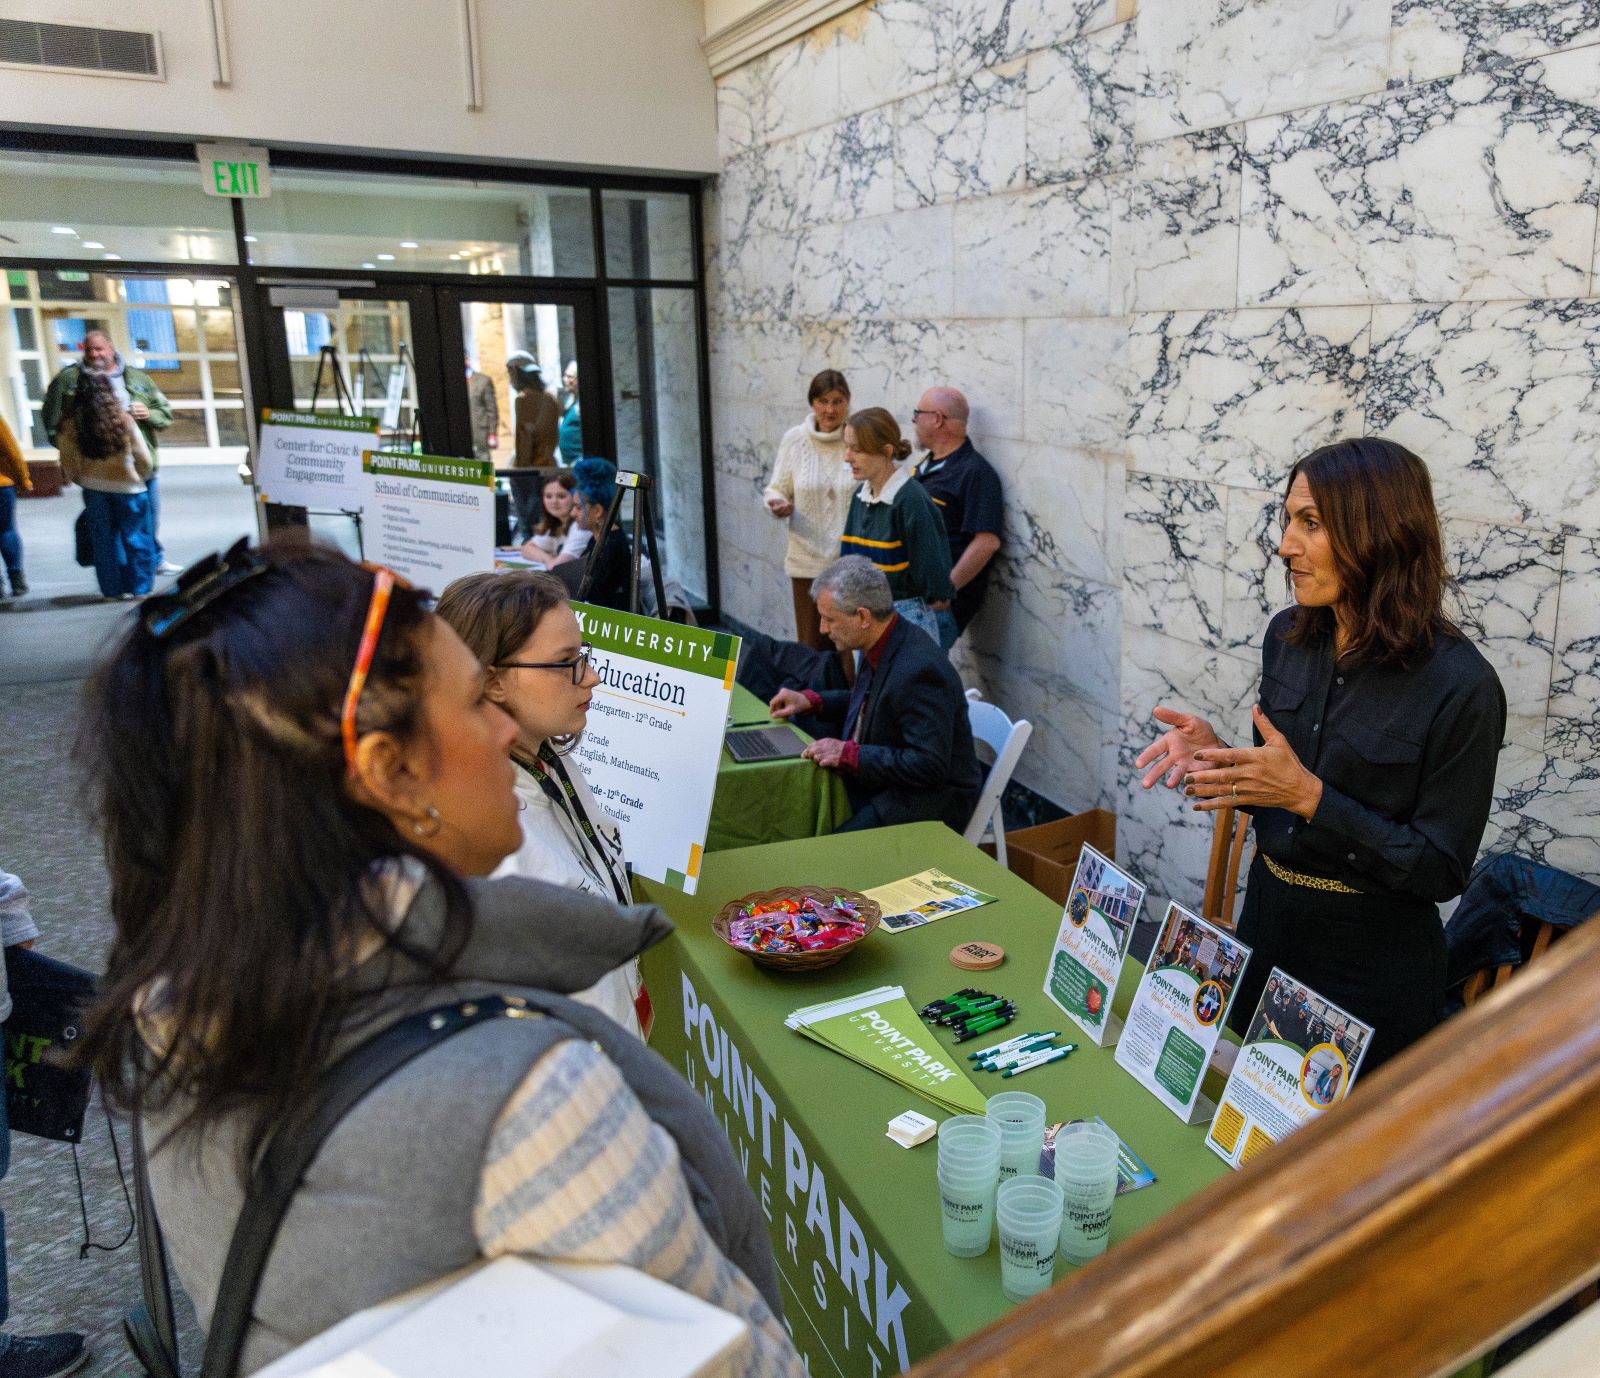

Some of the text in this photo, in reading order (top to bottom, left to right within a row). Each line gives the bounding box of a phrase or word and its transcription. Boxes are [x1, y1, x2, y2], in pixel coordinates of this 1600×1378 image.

[213, 160, 259, 195] EXIT
[316, 416, 371, 429] UNIVERSITY
[276, 438, 360, 456] Center for Civic &
[288, 454, 346, 471] Community
[421, 463, 482, 478] UNIVERSITY
[285, 467, 345, 484] Engagement
[375, 481, 480, 506] School of Communication
[588, 619, 712, 661] UNIVERSITY
[589, 700, 630, 720] ndergarten
[649, 716, 673, 732] Grade
[587, 732, 610, 747] Grade
[579, 746, 660, 781] English, Mathematics,
[604, 804, 631, 823] Studies
[620, 793, 644, 810] Grade
[1082, 926, 1117, 961] POINT PARK
[1151, 972, 1191, 1007] POINT PARK
[849, 1016, 938, 1086] UNIVERSITY
[861, 1010, 958, 1082] POINT PARK
[1246, 1056, 1297, 1097] UNIVERSITY
[1249, 1046, 1300, 1090] POINT PARK
[681, 969, 912, 1377] POINT PARK
[1000, 1165, 1018, 1174] ARK
[686, 1050, 882, 1378] UNIVERSIT
[960, 1203, 983, 1211] PARK
[1069, 1210, 1095, 1220] POINT
[1082, 1219, 1107, 1230] POINT
